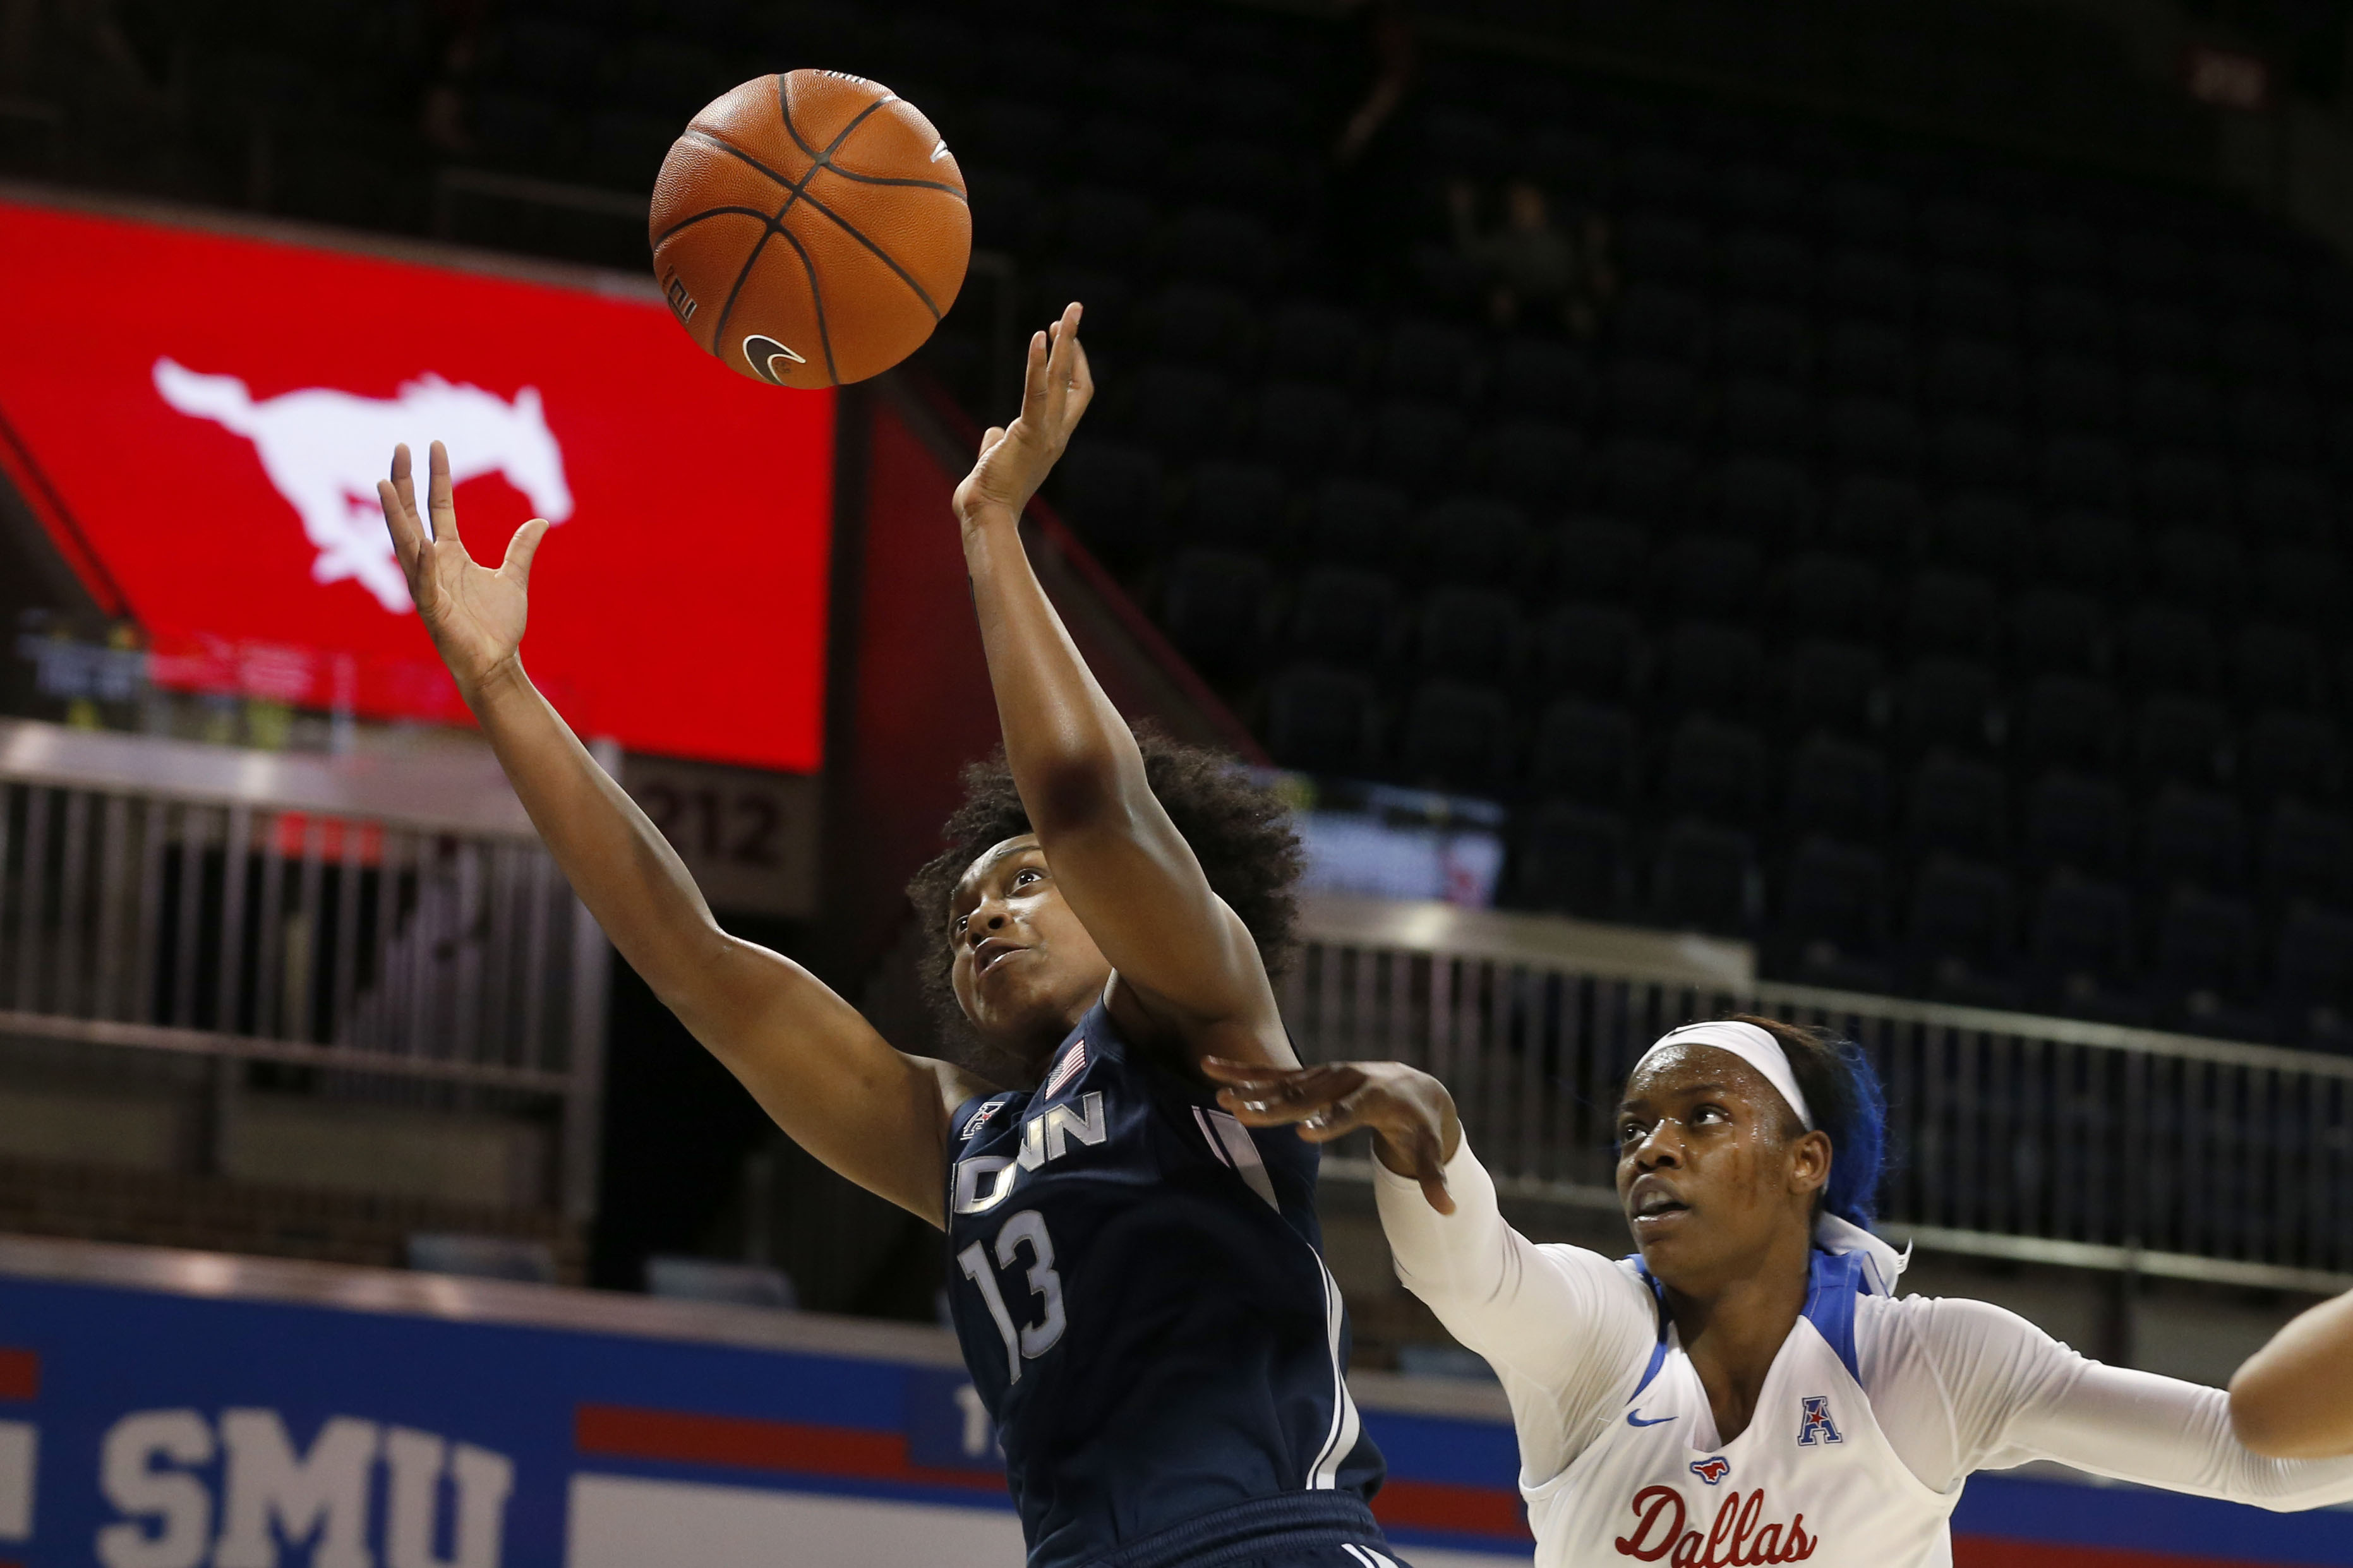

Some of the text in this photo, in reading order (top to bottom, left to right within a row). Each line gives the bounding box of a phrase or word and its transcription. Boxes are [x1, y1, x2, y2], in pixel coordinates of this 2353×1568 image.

[957, 1209, 1068, 1385] 13
[95, 1406, 517, 1568] SMU
[1615, 1485, 1817, 1568] Dallas
